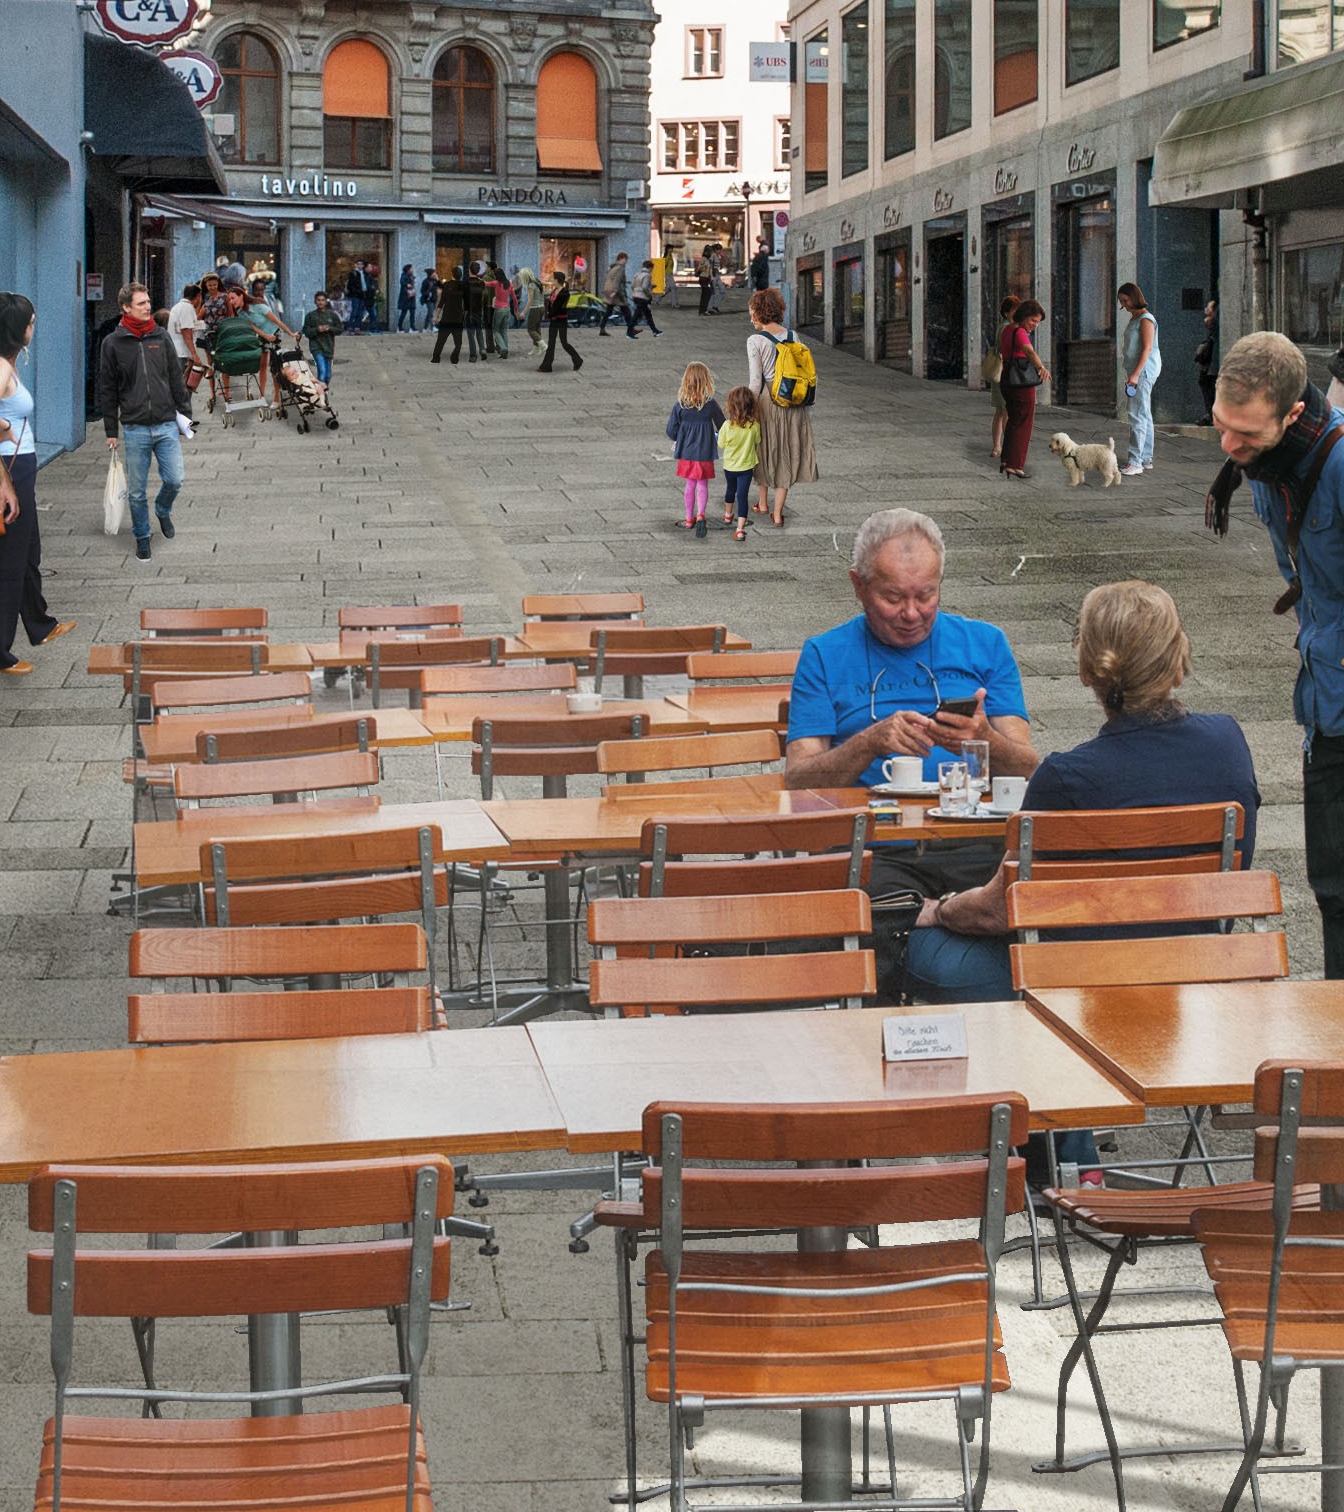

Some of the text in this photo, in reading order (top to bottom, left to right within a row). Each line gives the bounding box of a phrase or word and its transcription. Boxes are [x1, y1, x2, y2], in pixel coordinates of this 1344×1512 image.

[766, 57, 787, 67] UBS
[1066, 143, 1095, 174] Cartier
[261, 175, 357, 197] tavolino
